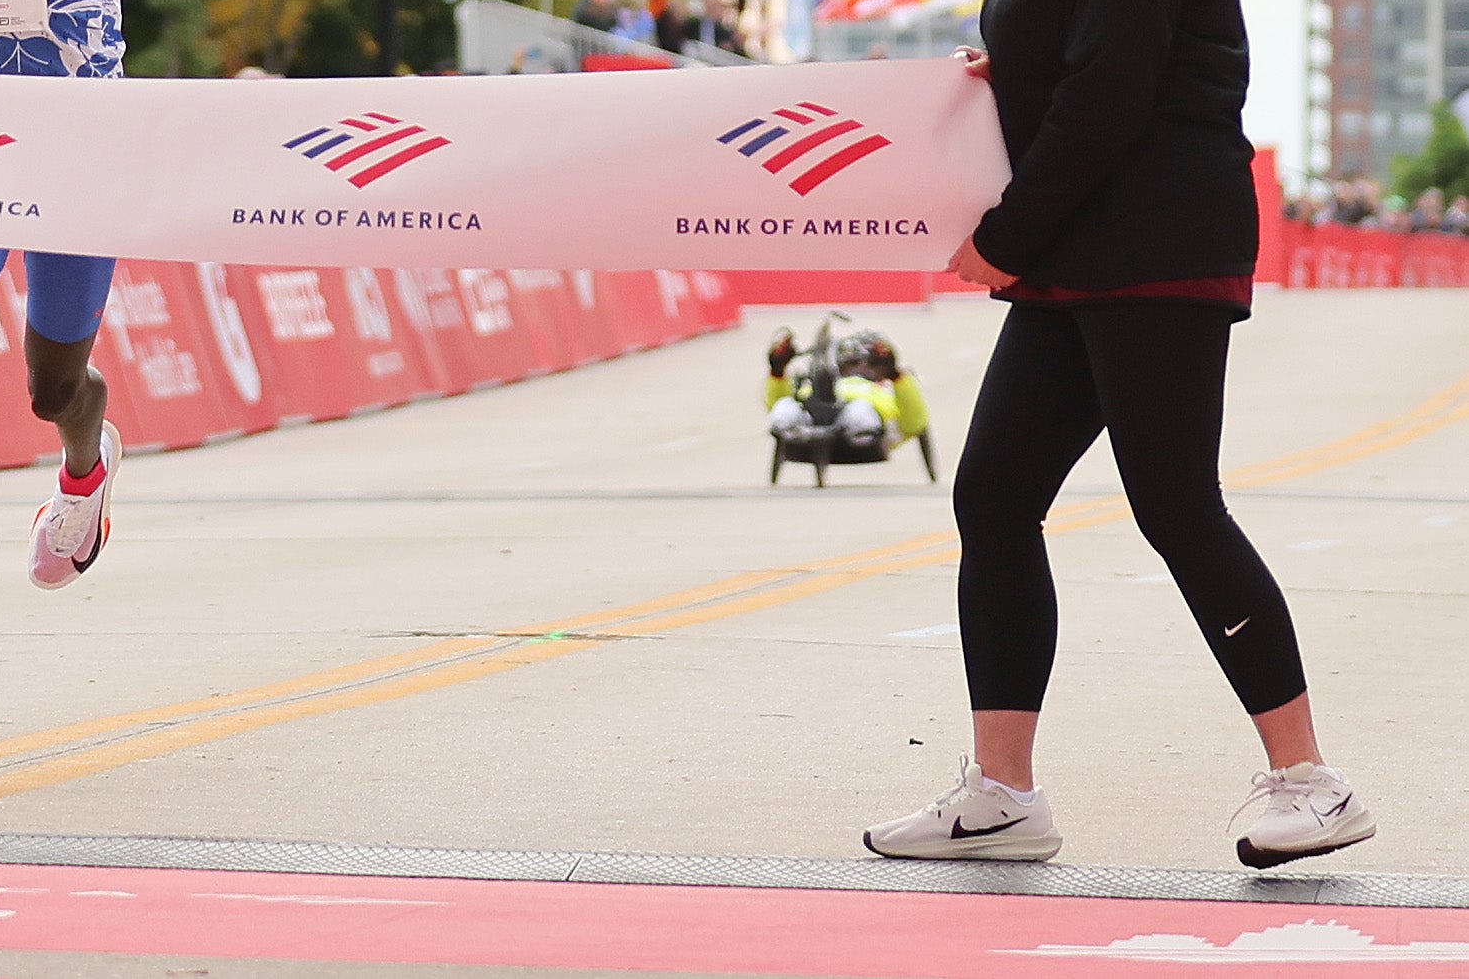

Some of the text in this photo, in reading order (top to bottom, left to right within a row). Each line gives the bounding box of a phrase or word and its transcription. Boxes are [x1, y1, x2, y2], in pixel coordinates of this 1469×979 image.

[232, 208, 482, 231] BANK OF AMERICA
[676, 217, 929, 236] BANK OF AMERICA
